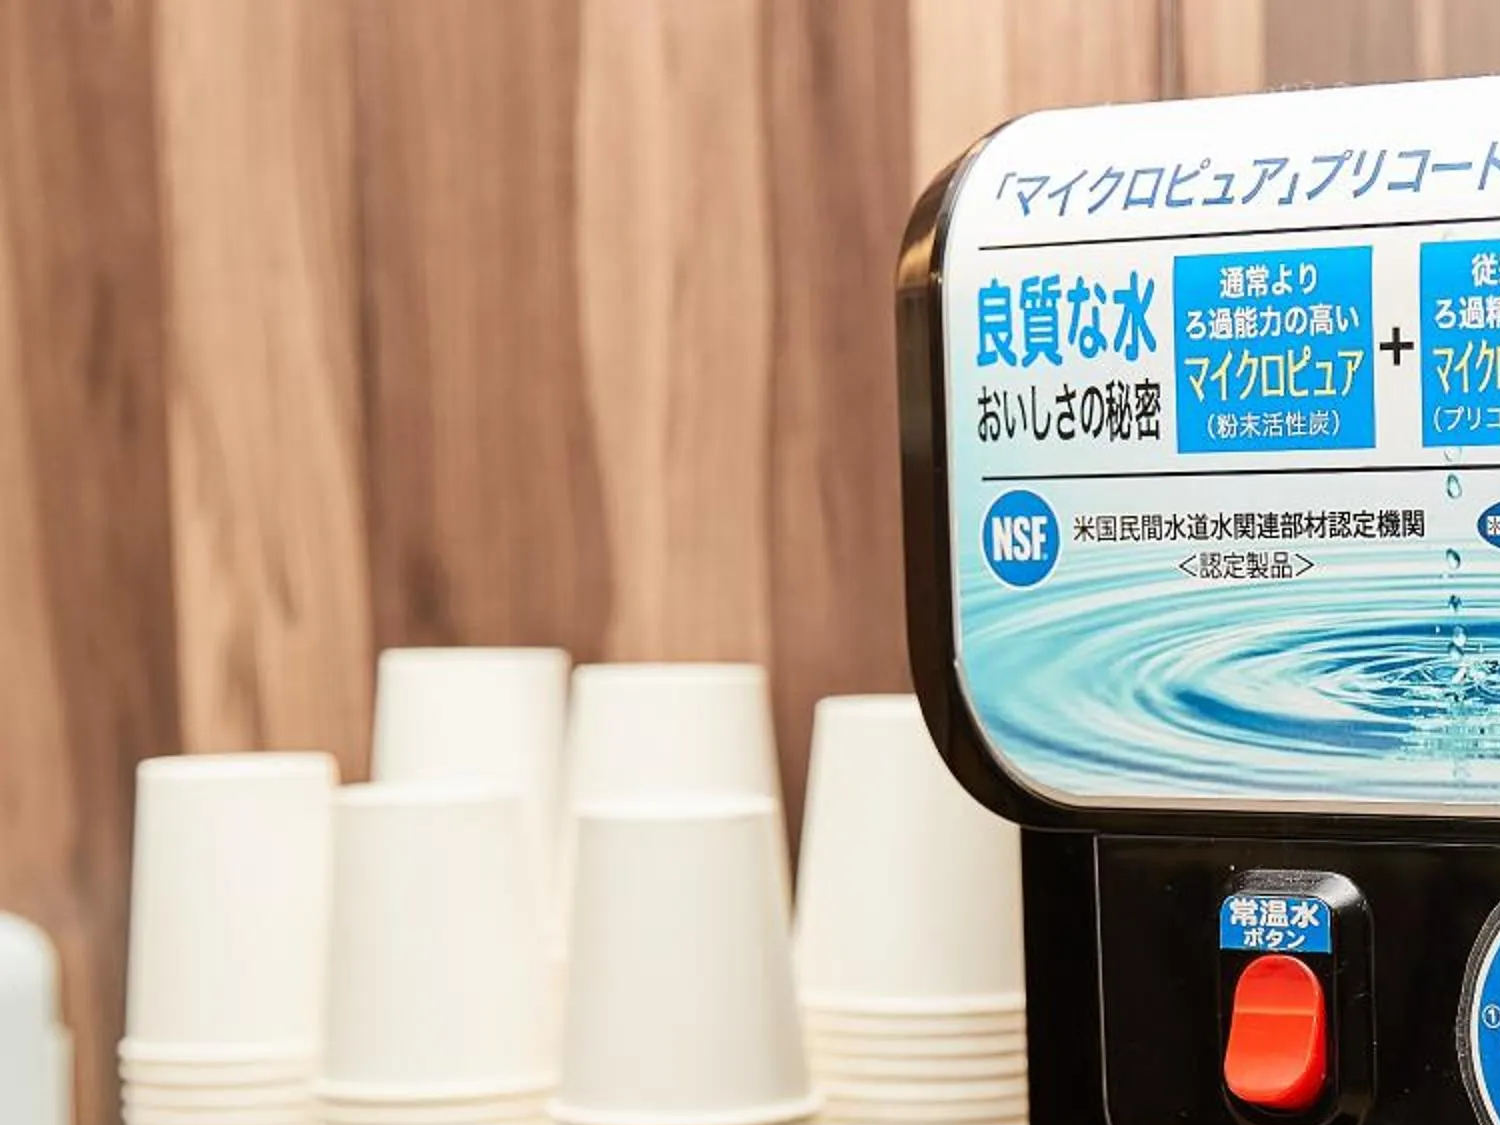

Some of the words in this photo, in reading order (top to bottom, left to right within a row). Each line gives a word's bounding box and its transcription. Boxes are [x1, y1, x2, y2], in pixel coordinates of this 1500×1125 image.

[1219, 261, 1318, 299] 通常より
[976, 270, 1157, 368] 良質な水
[1186, 303, 1360, 340] ろ過能力の高い
[1184, 345, 1365, 402] マイクロピュア
[977, 378, 1161, 443] おいしさの秘密
[991, 515, 1047, 561] NSF
[1073, 509, 1426, 542] 米国民間水道水関連部材認定機関
[1229, 899, 1321, 928] 常温水
[1243, 928, 1306, 949] ボタン
